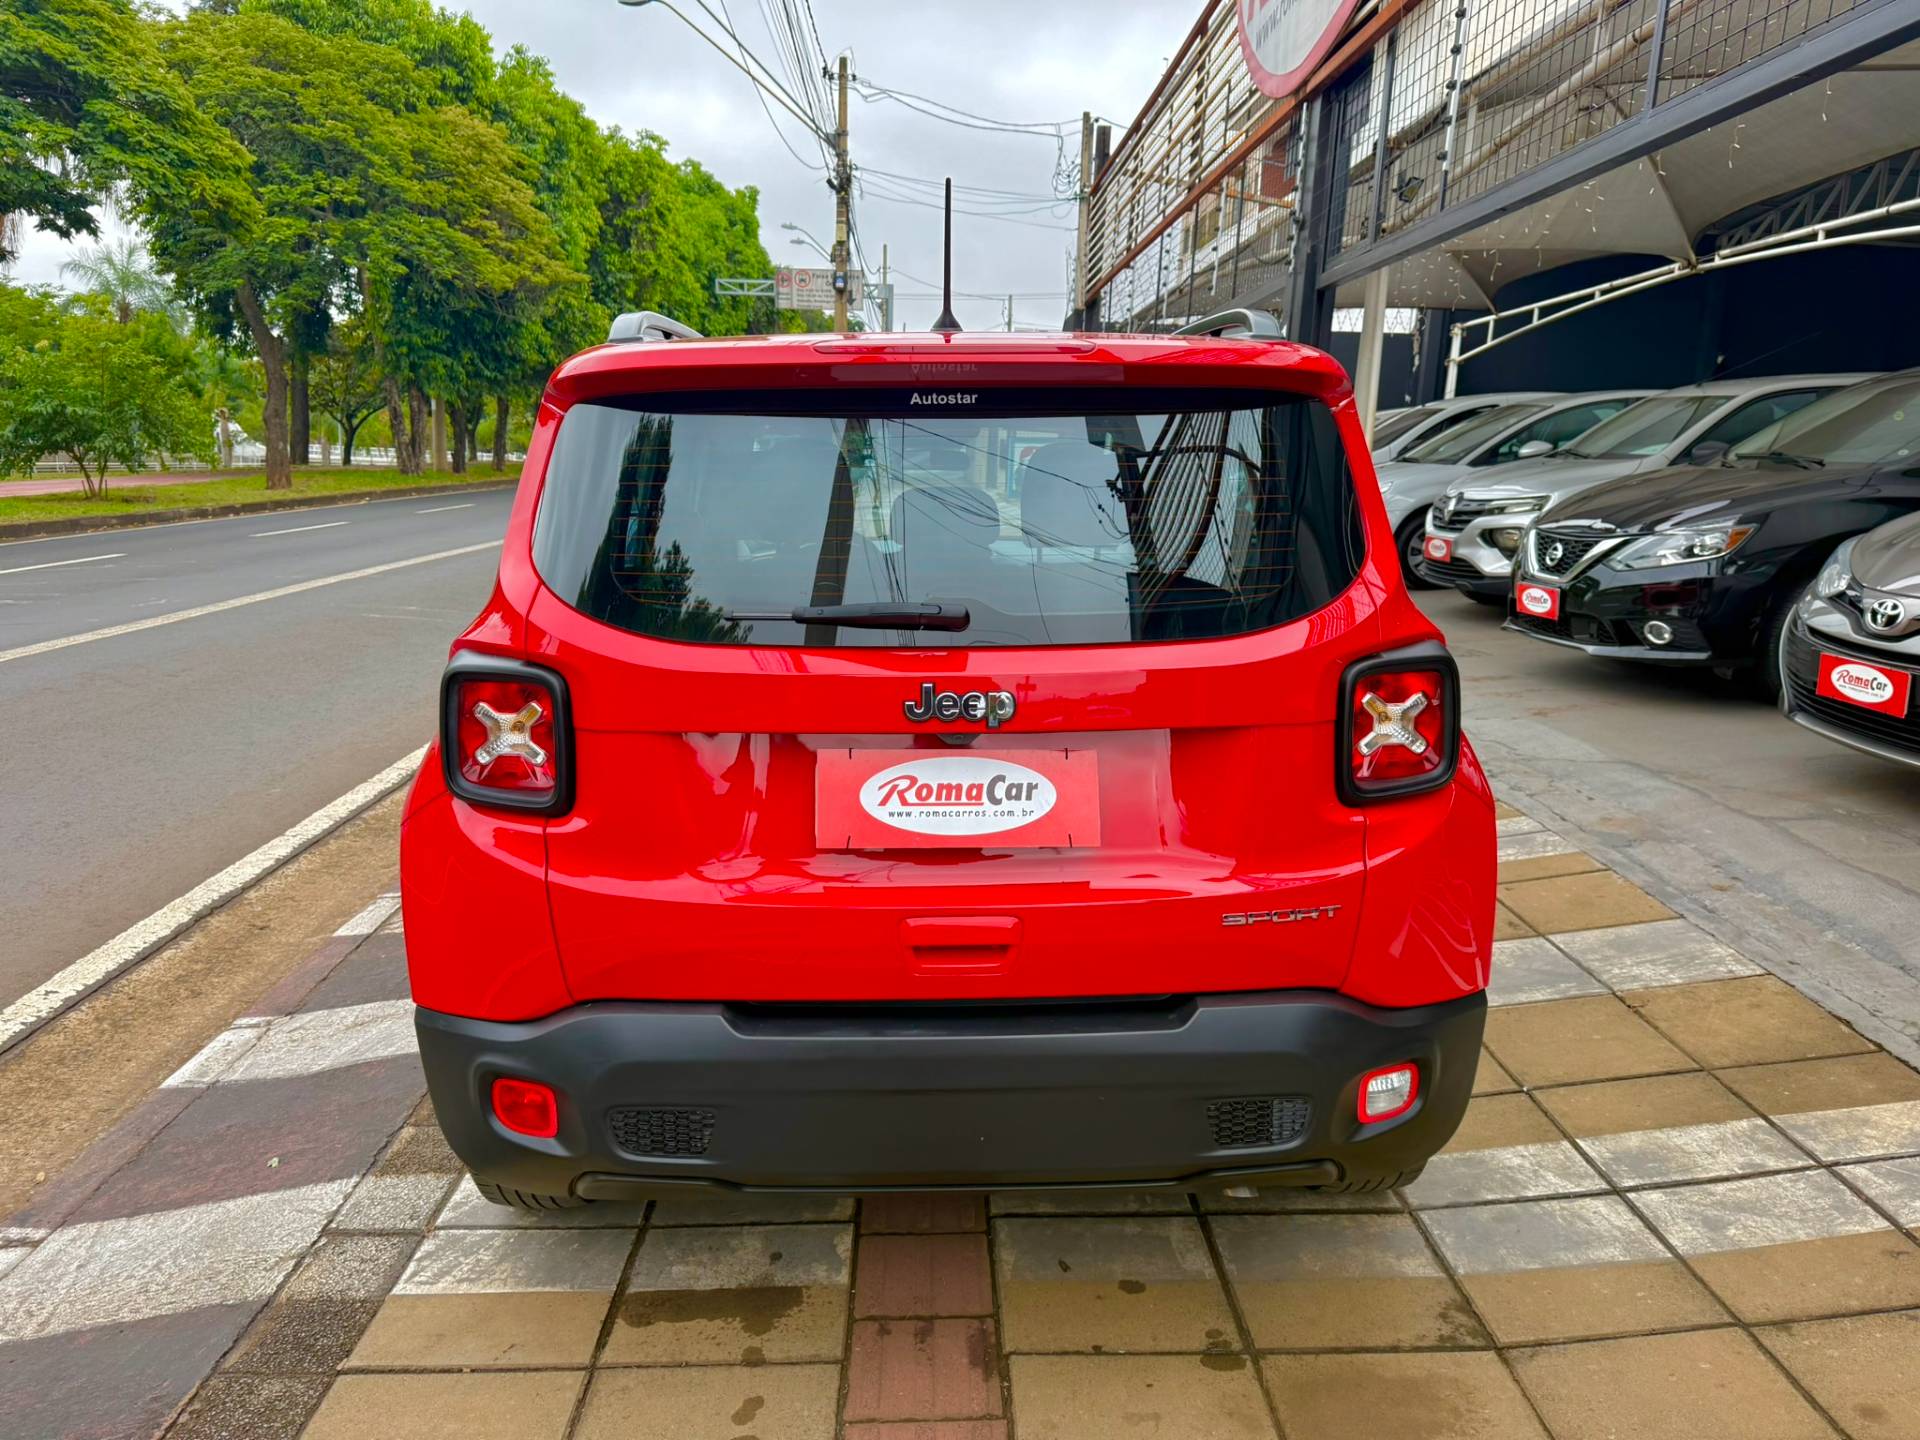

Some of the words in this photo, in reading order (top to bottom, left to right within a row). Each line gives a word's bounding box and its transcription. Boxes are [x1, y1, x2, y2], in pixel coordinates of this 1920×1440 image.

[910, 392, 978, 405] Autostar
[1836, 669, 1888, 692] RomaCar
[904, 682, 1016, 728] Jeep
[877, 774, 1039, 806] RomaCar
[888, 808, 1035, 818] www.romacarros.com.br
[1222, 904, 1342, 926] SPORT
